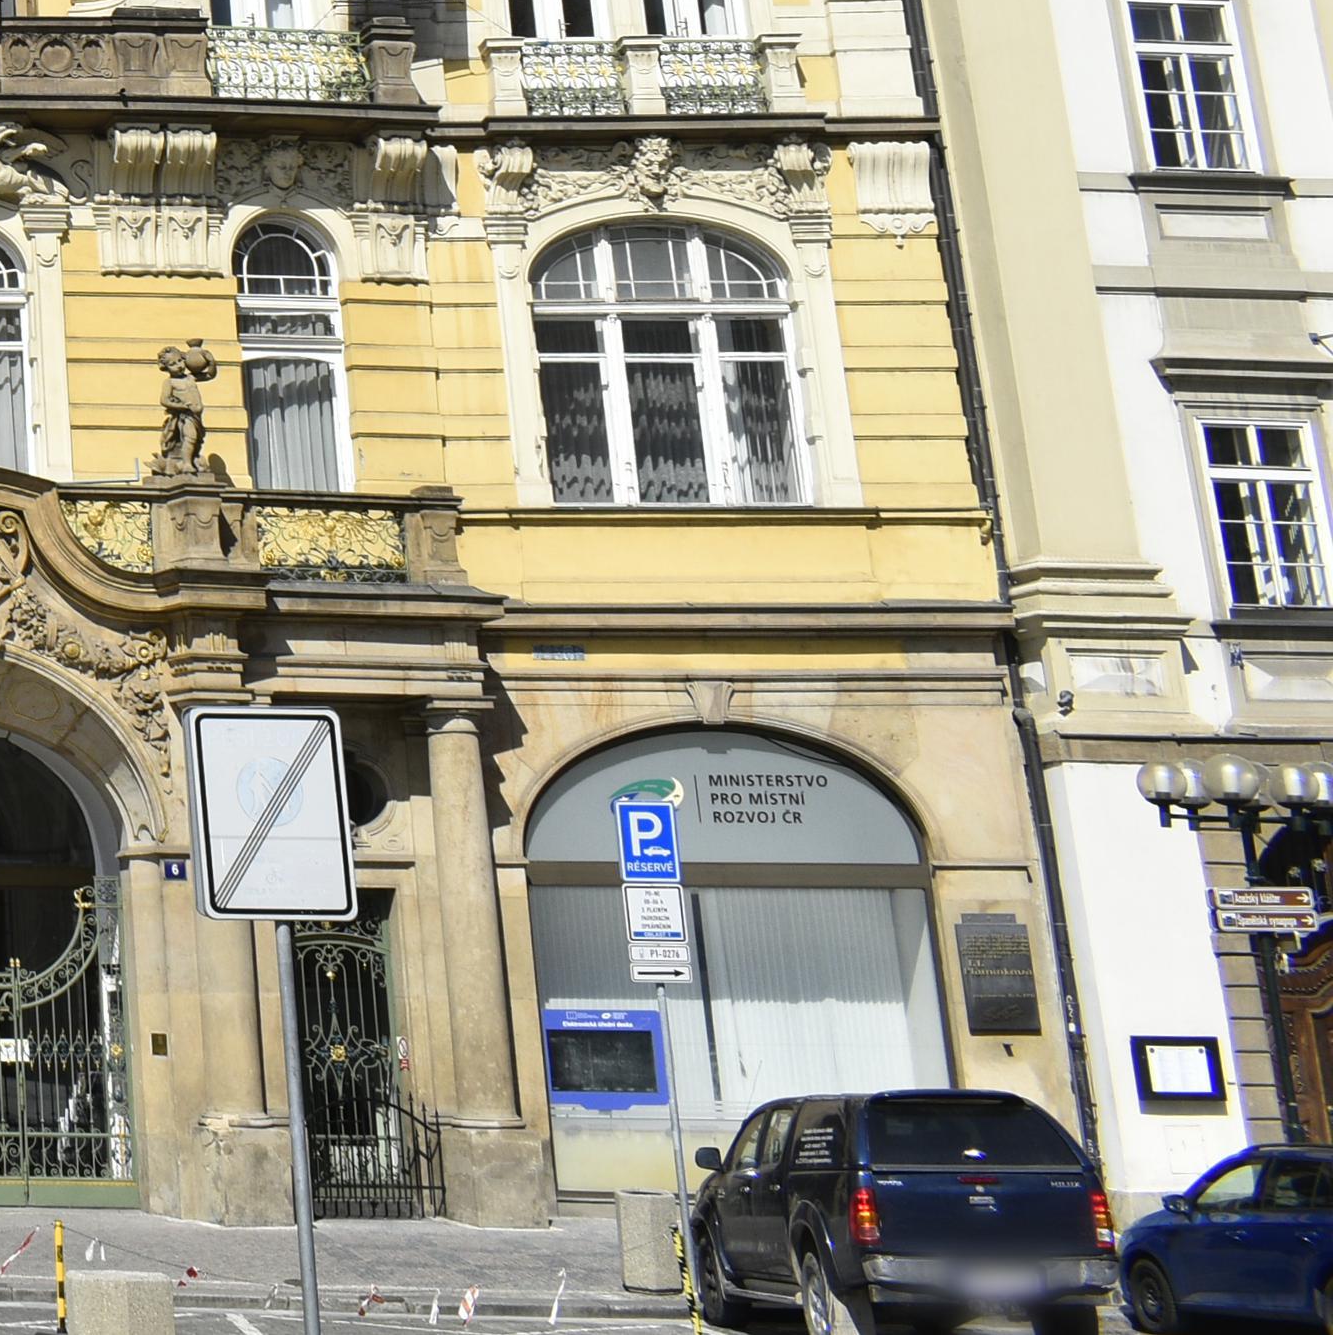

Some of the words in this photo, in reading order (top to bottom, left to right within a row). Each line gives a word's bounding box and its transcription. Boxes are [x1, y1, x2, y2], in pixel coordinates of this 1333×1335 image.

[708, 774, 828, 787] MINISTERSTVO
[711, 793, 742, 805] PRO
[749, 791, 805, 805] MÍSTNÍ
[713, 811, 776, 823] ROZVOJ
[782, 809, 802, 823] ČR
[628, 811, 663, 856] P
[171, 864, 180, 875] 6
[626, 860, 674, 873] RÉSERVÉ
[650, 949, 680, 958] P1-0276
